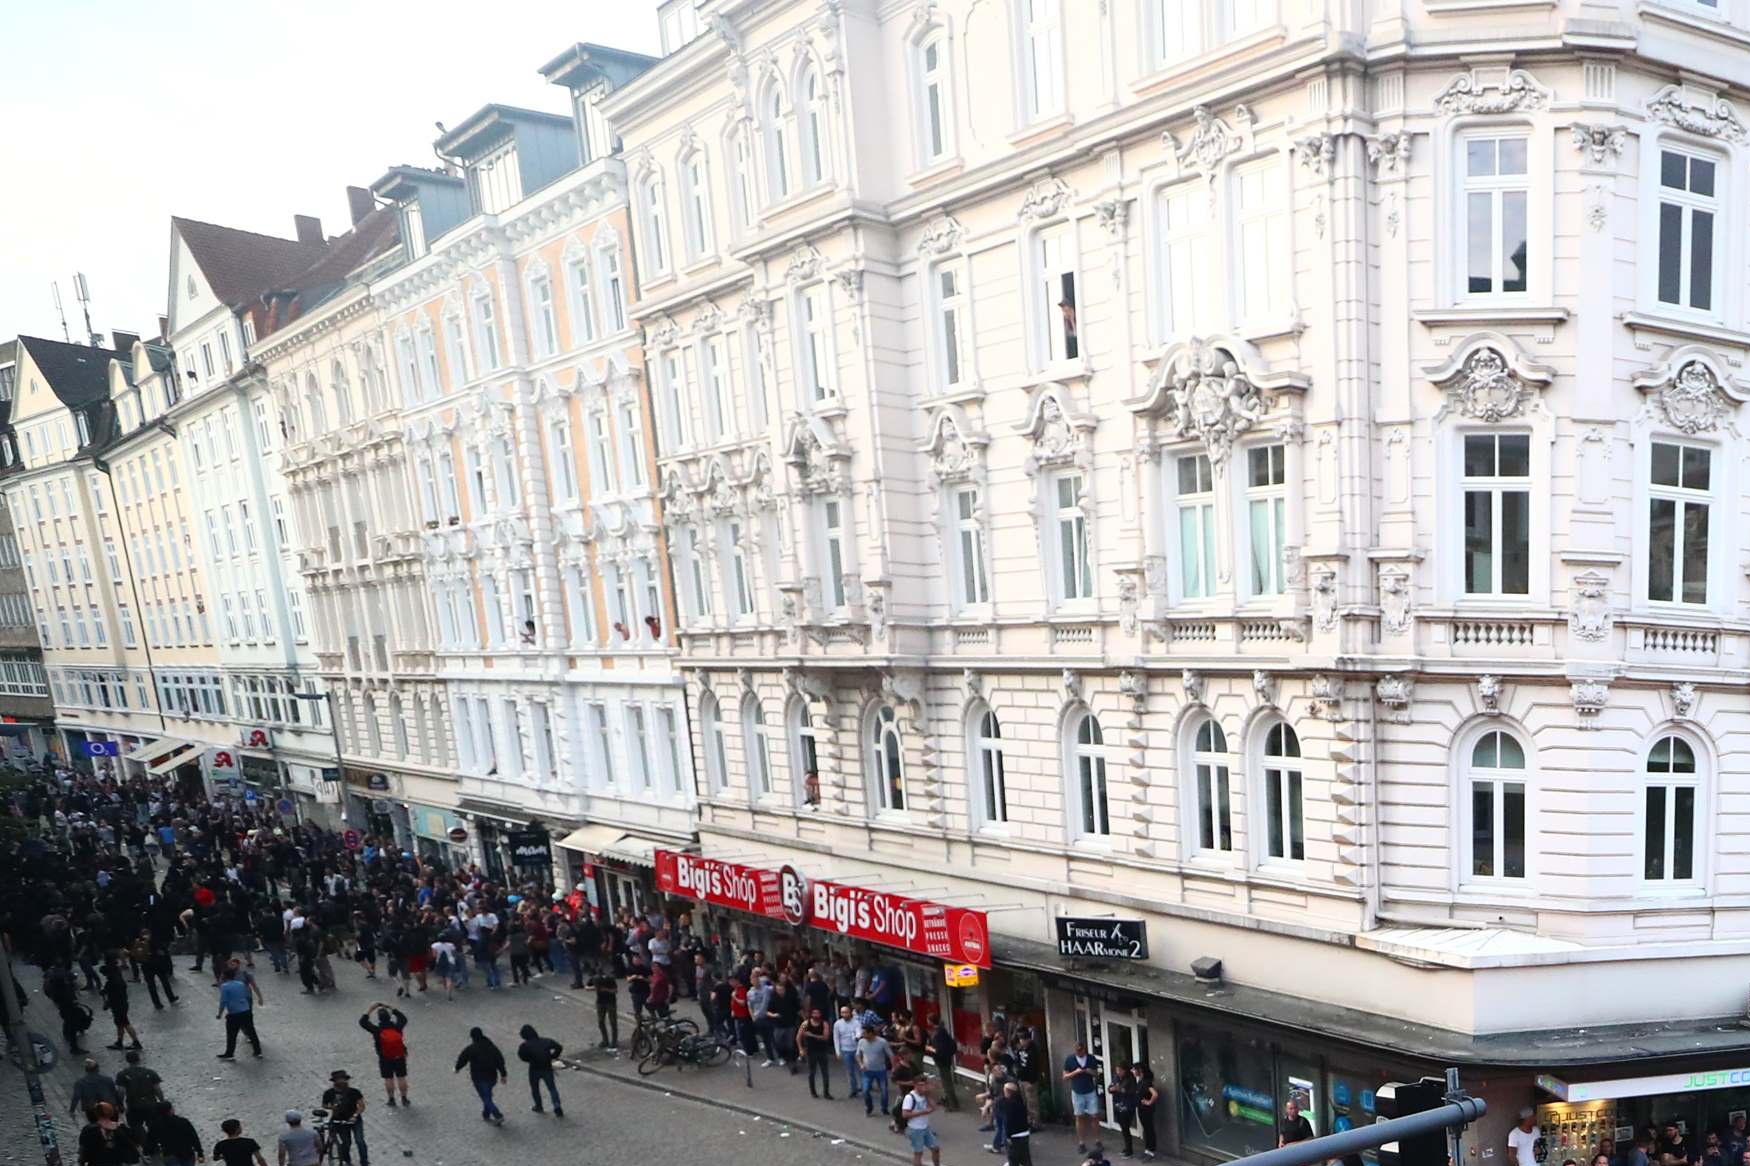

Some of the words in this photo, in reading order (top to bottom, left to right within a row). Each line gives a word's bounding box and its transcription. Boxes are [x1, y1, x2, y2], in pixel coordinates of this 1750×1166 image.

[677, 856, 722, 899] Bigi's
[723, 865, 757, 910] Shop
[813, 883, 870, 932] Bigi's
[874, 895, 917, 947] Shop
